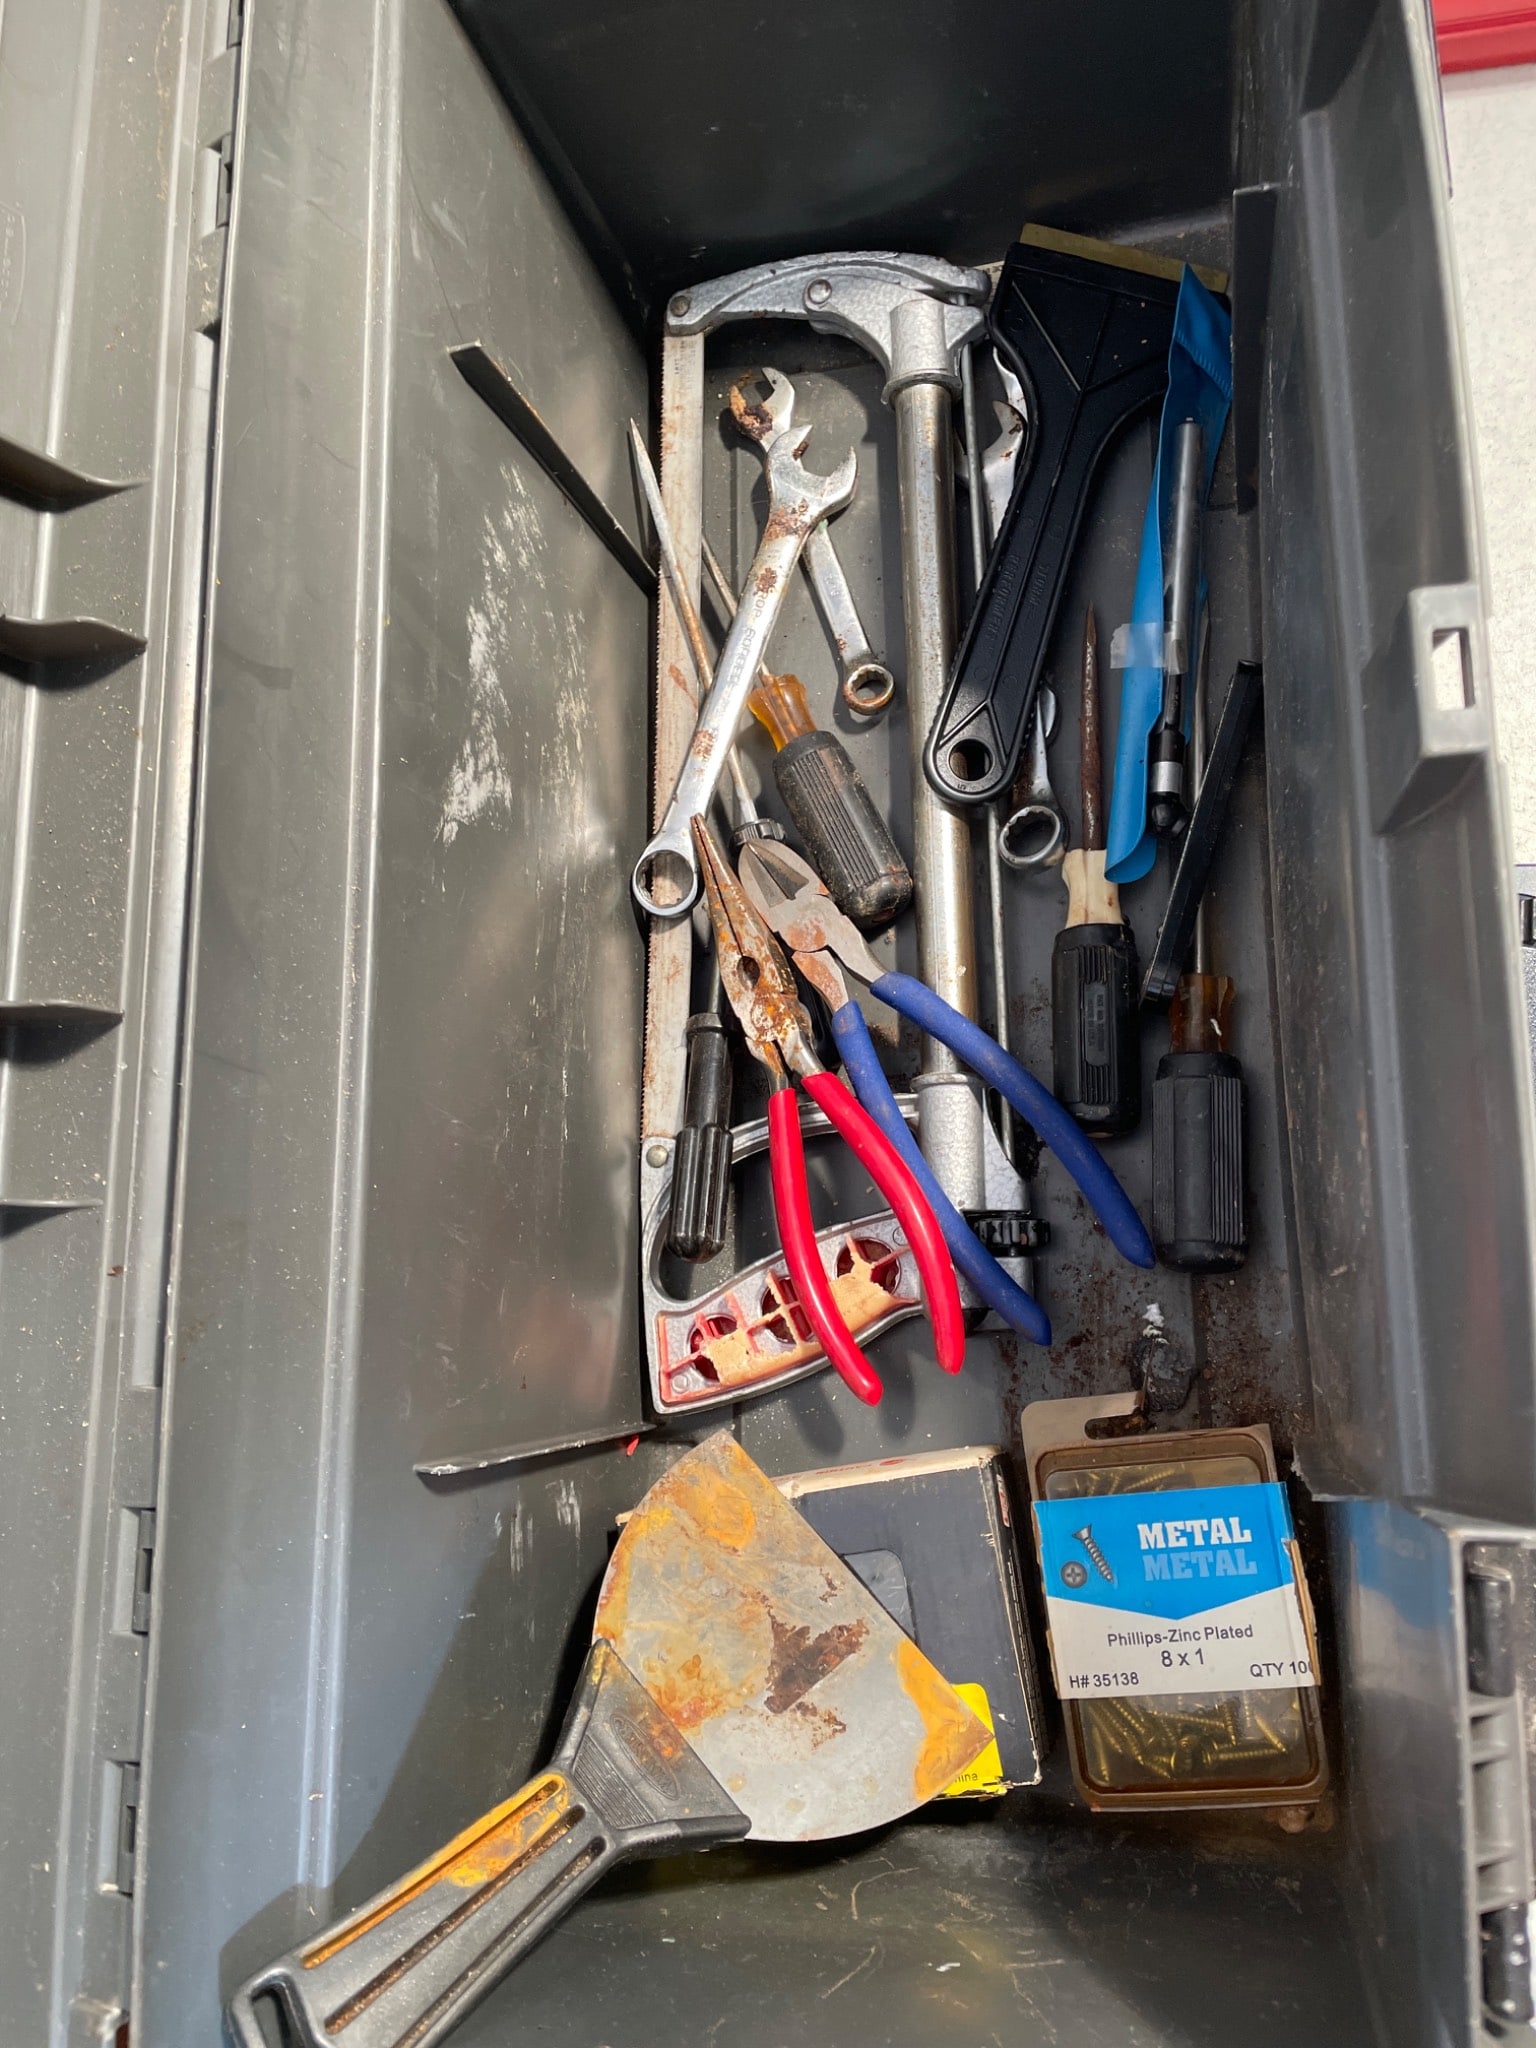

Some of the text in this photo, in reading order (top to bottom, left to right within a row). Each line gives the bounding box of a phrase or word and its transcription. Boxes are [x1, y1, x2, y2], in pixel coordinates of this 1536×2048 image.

[1137, 1516, 1253, 1550] METAL
[1142, 1549, 1257, 1581] METAL
[1107, 1624, 1254, 1647] Phillips-Zinc Plated
[1161, 1648, 1204, 1667] 8 x 1
[1069, 1671, 1139, 1688] H# 35138
[1250, 1662, 1284, 1677] QTY
